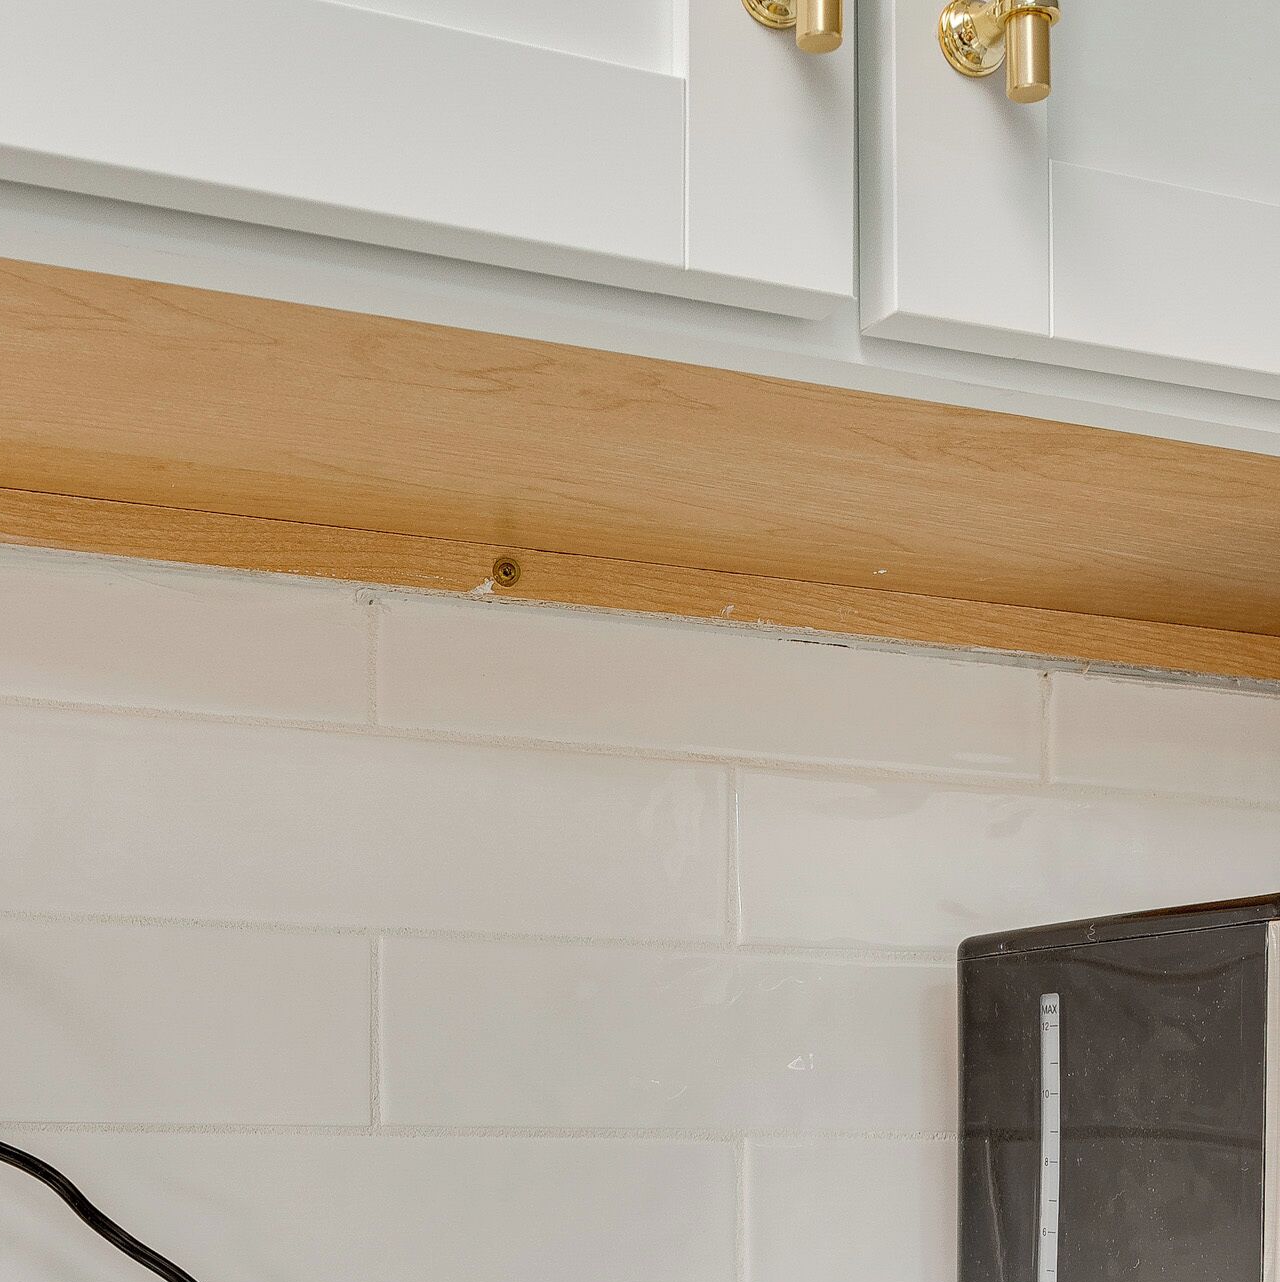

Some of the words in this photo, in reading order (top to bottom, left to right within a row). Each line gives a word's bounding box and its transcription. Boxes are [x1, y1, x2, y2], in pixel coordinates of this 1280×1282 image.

[1042, 1005, 1057, 1014] MAX
[1042, 1022, 1049, 1031] 12
[1042, 1090, 1050, 1098] 10
[1045, 1157, 1049, 1166] 8
[1042, 1228, 1046, 1236] 6
